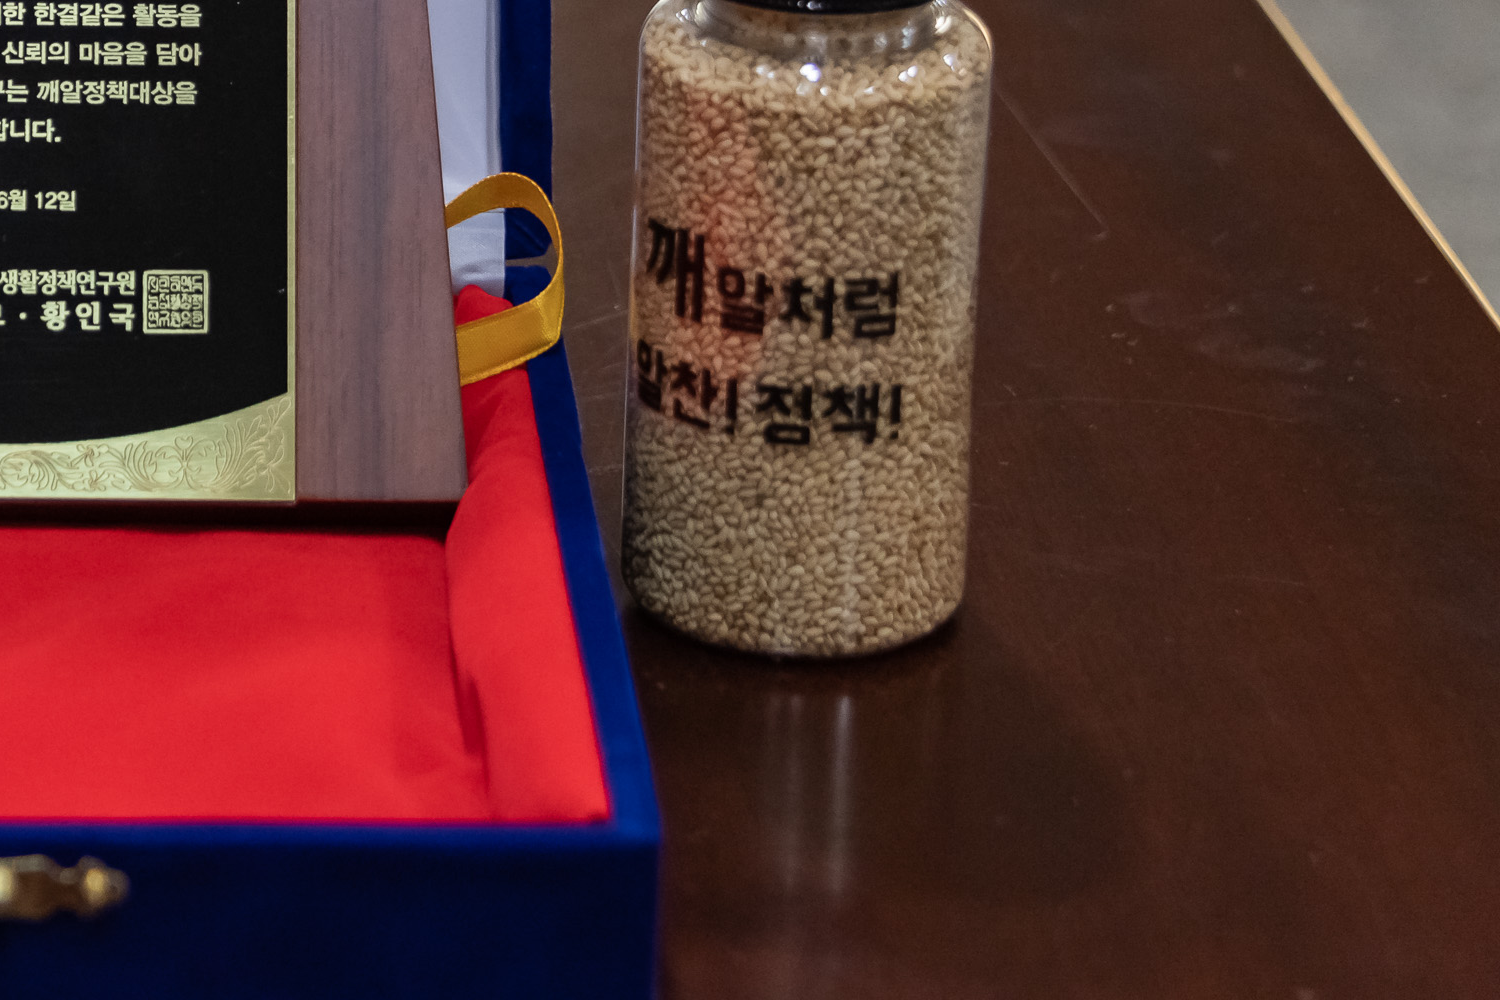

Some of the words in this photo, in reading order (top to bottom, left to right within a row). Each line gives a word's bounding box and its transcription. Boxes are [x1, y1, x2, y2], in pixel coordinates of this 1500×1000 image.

[33, 2, 126, 27] 한결같은
[132, 3, 202, 28] 활동을
[1, 41, 70, 65] 신뢰의
[79, 42, 148, 66] 마음을
[156, 42, 202, 67] 담아
[36, 80, 198, 105] 깨알정책대상을
[34, 190, 76, 212] 12일
[646, 217, 899, 340] 깨알처럼
